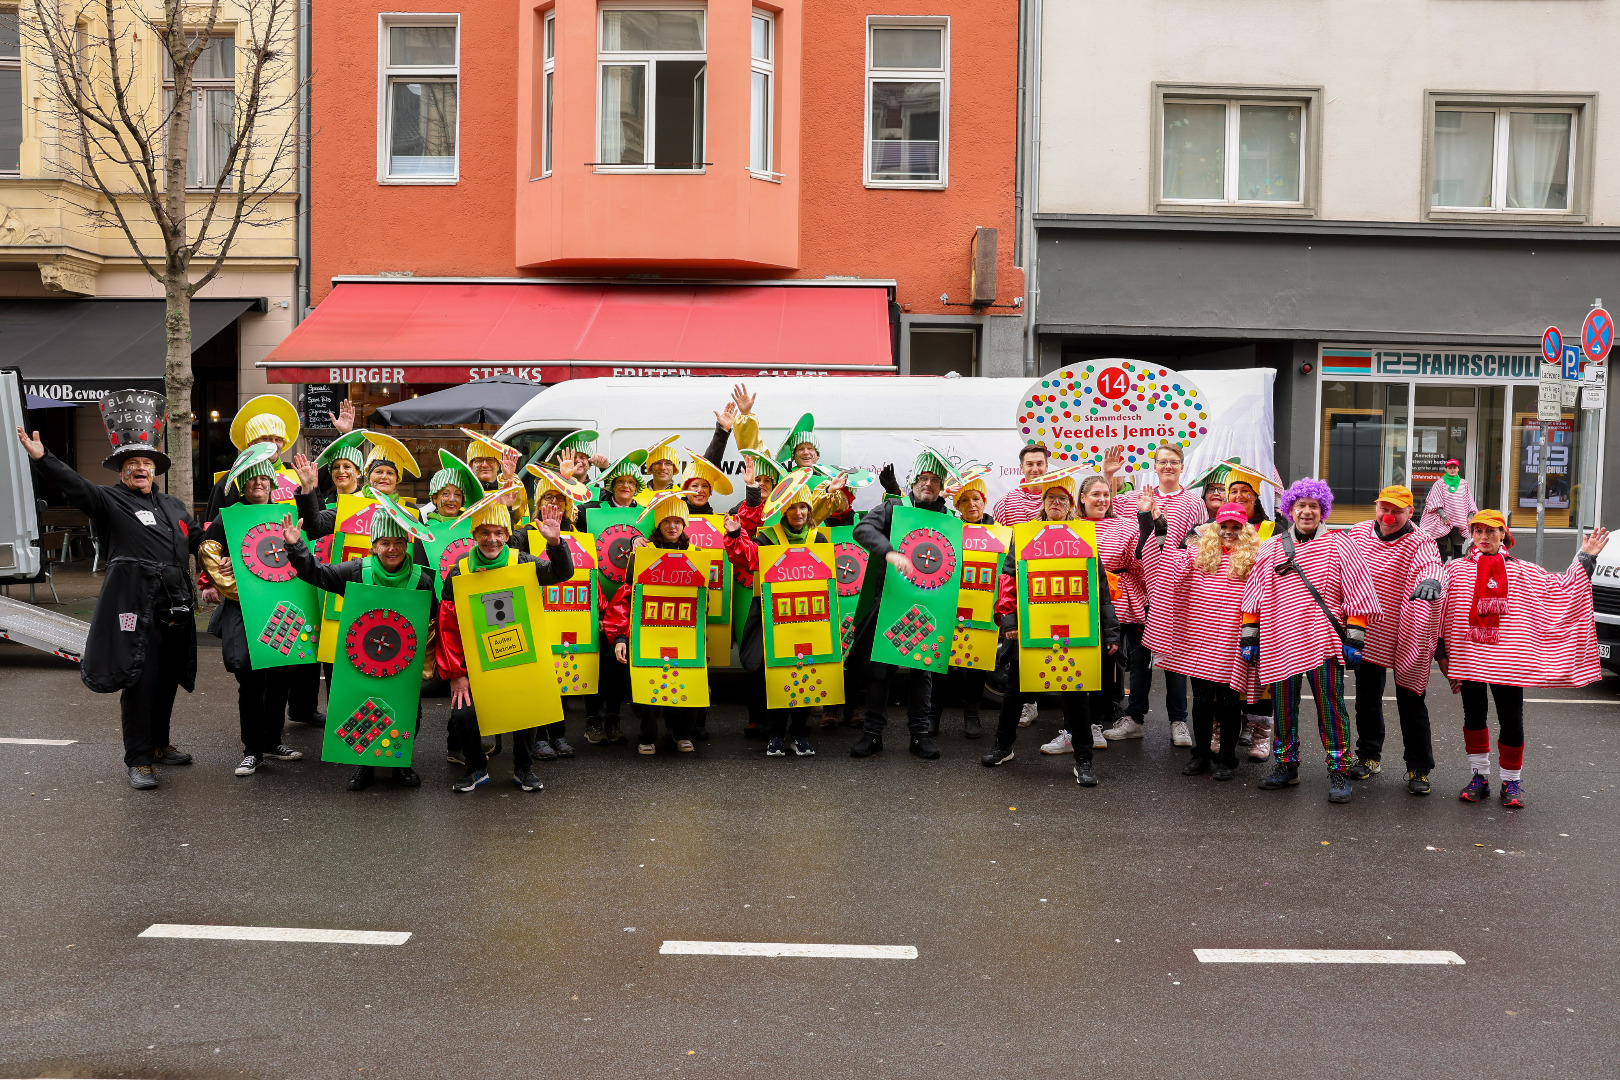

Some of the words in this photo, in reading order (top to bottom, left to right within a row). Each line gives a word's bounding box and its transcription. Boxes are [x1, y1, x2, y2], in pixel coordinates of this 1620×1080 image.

[1566, 350, 1576, 378] P
[329, 368, 405, 383] BURGER
[1100, 373, 1127, 393] 14
[108, 394, 156, 408] BLACK
[117, 412, 154, 424] JECK
[1084, 413, 1142, 422] Stammdesch
[1051, 424, 1118, 439] Veedels
[1122, 424, 1175, 440] Jemös
[1525, 465, 1568, 474] FAHCHULE
[962, 538, 988, 550] OTS
[1033, 540, 1081, 557] SLOTS
[650, 568, 695, 585] SLOTS
[777, 565, 815, 582] SLOTS
[1596, 564, 1620, 579] VEC
[495, 643, 517, 654] Betrieb
